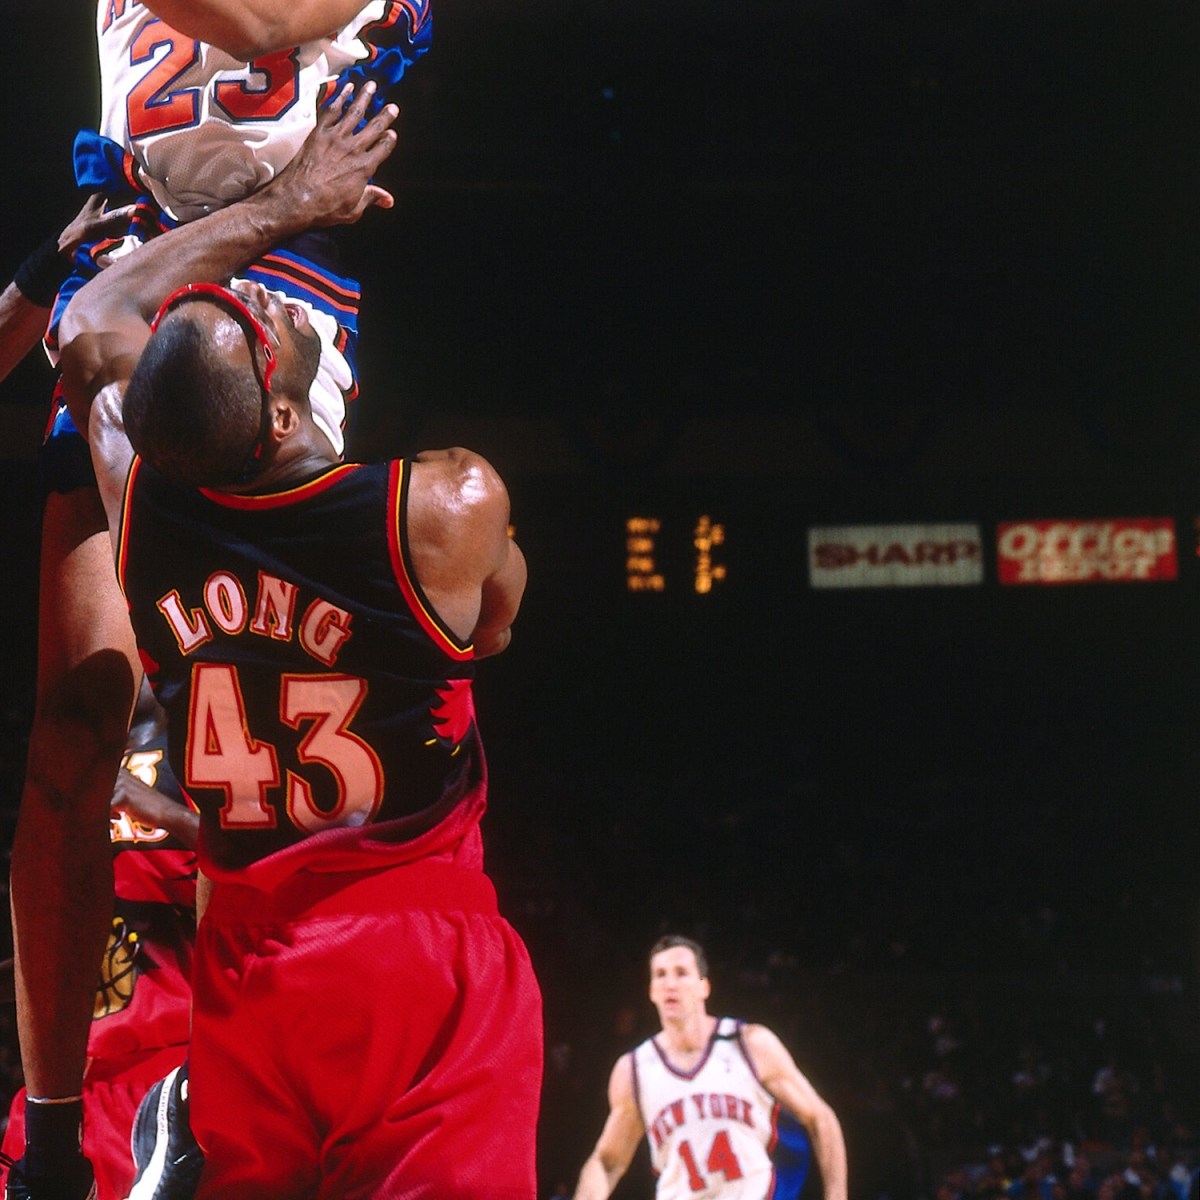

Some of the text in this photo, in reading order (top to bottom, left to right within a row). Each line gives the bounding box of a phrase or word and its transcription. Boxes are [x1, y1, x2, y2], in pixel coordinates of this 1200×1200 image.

[127, 18, 300, 141] 23
[814, 540, 978, 569] SHARP
[1001, 522, 1174, 560] Office
[156, 569, 352, 667] LONG
[184, 662, 384, 834] 43
[691, 1093, 757, 1129] YORK
[678, 1130, 744, 1191] 14
